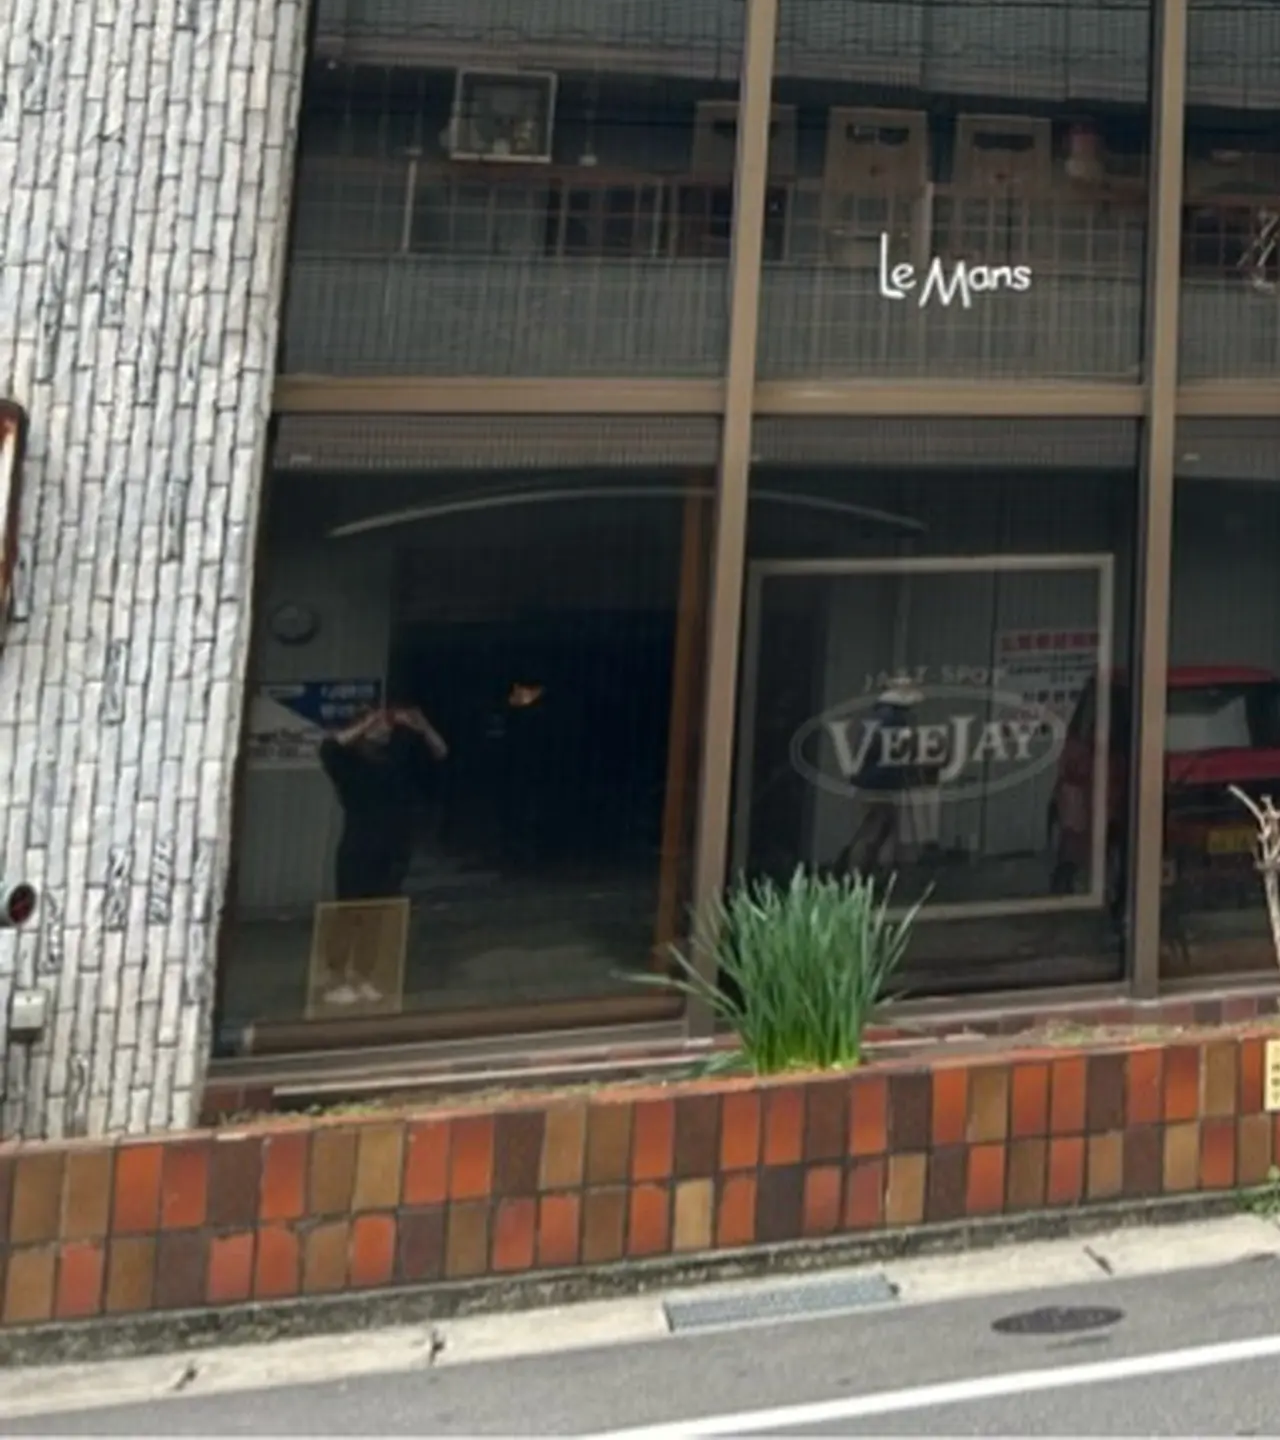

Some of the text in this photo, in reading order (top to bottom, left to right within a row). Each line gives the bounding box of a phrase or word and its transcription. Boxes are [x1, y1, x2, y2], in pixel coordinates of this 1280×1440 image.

[879, 231, 1033, 309] Le Mans
[825, 715, 1042, 783] VEEJAY
